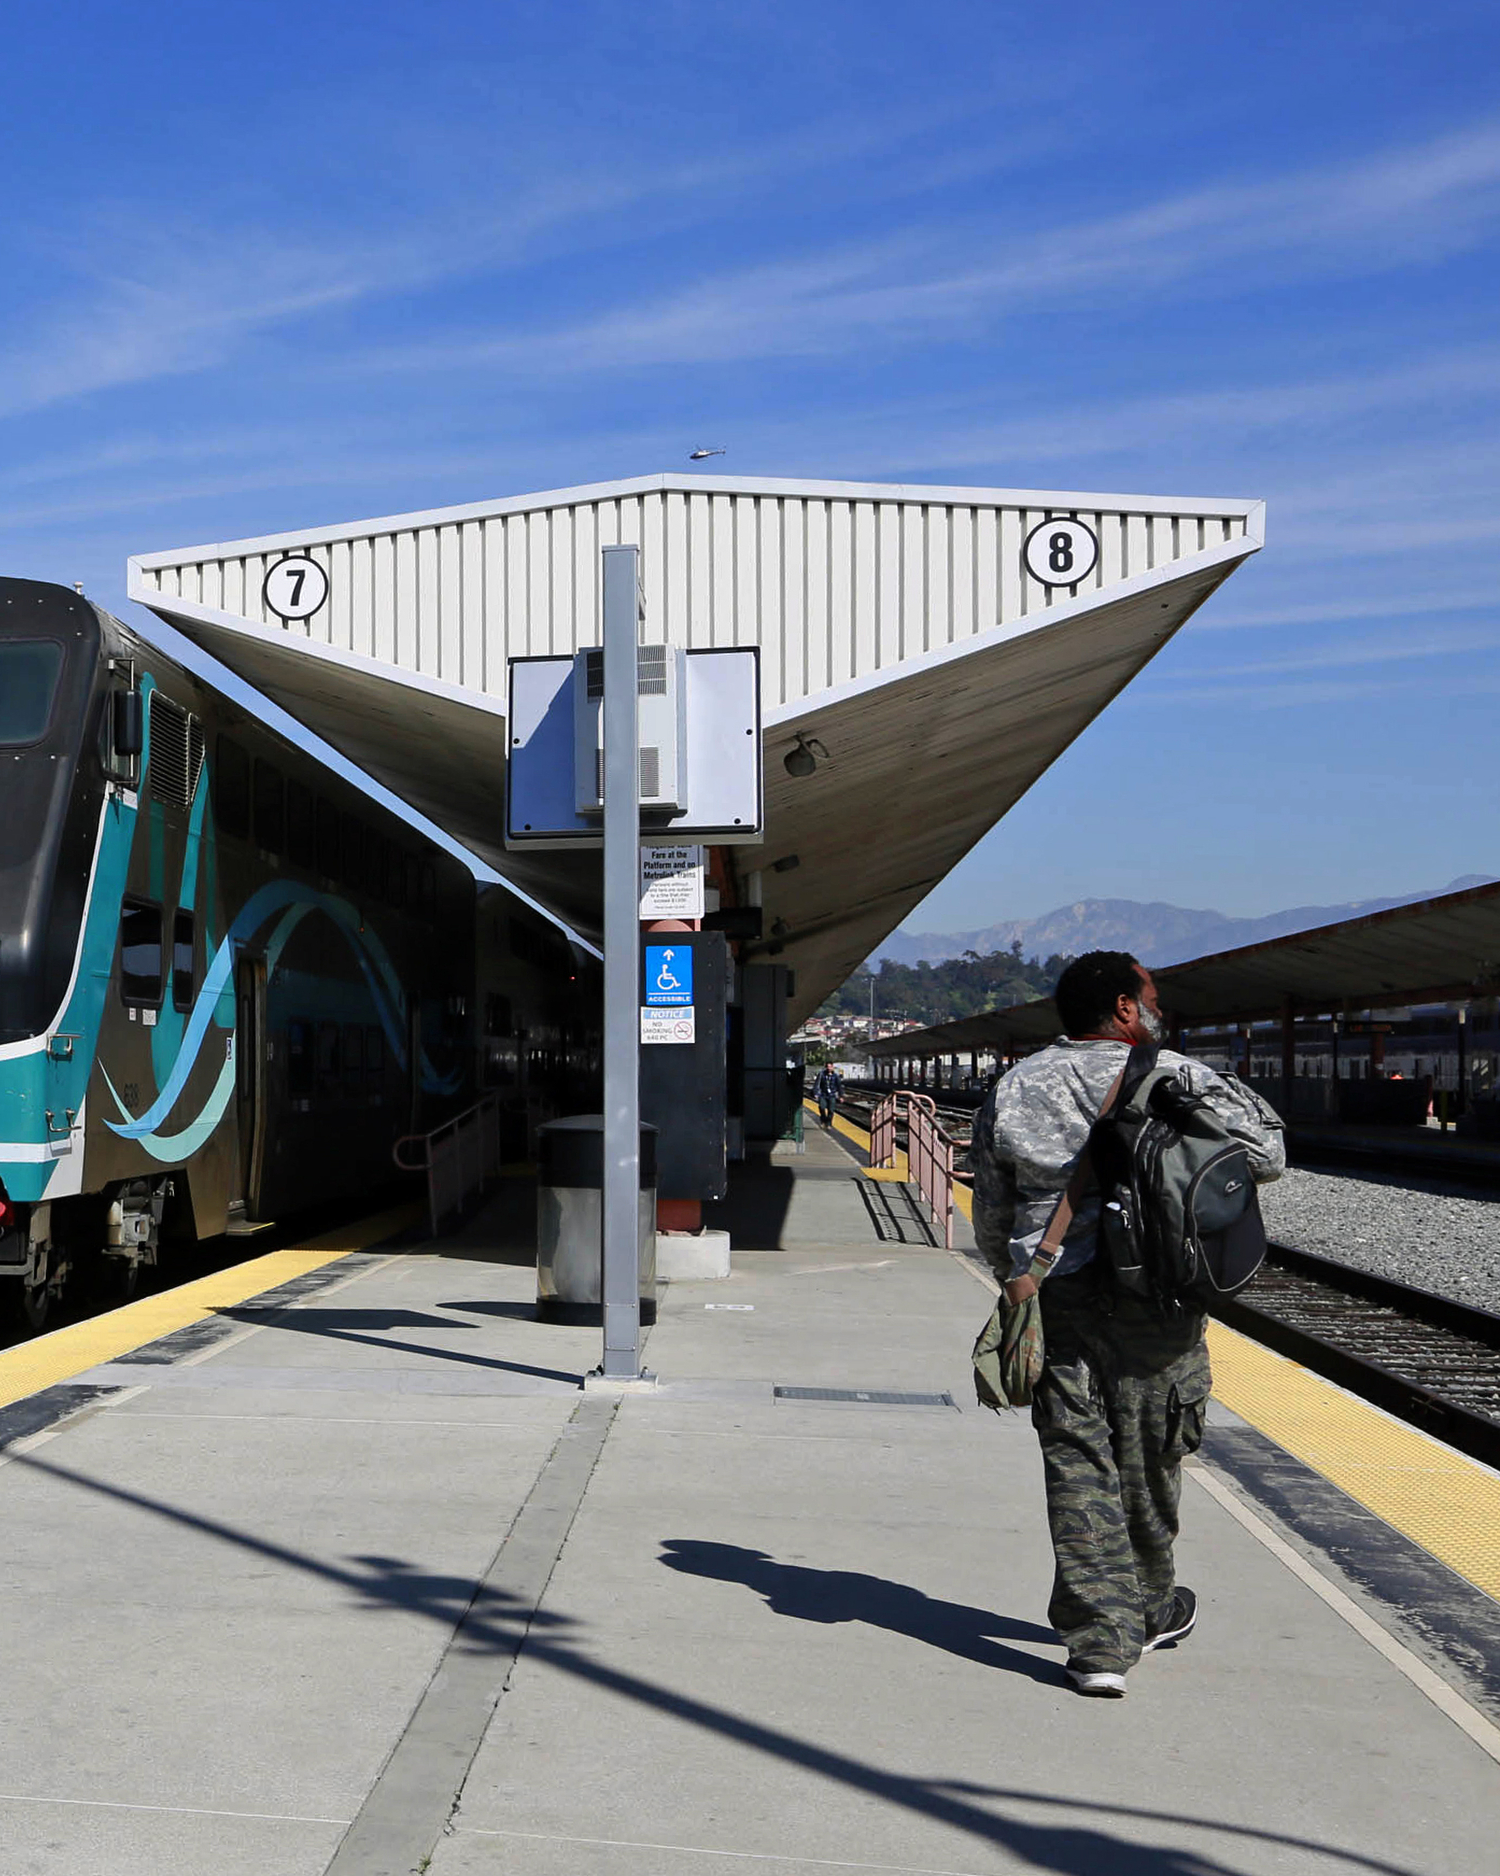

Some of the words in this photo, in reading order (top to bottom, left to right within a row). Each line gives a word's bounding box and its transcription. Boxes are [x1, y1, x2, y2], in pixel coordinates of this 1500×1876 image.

[1049, 531, 1073, 573] 8
[286, 569, 306, 607] 7
[652, 851, 666, 859] Fare
[644, 861, 671, 869] Platform
[644, 871, 674, 879] Metrolink
[650, 1010, 685, 1018] NOTICE
